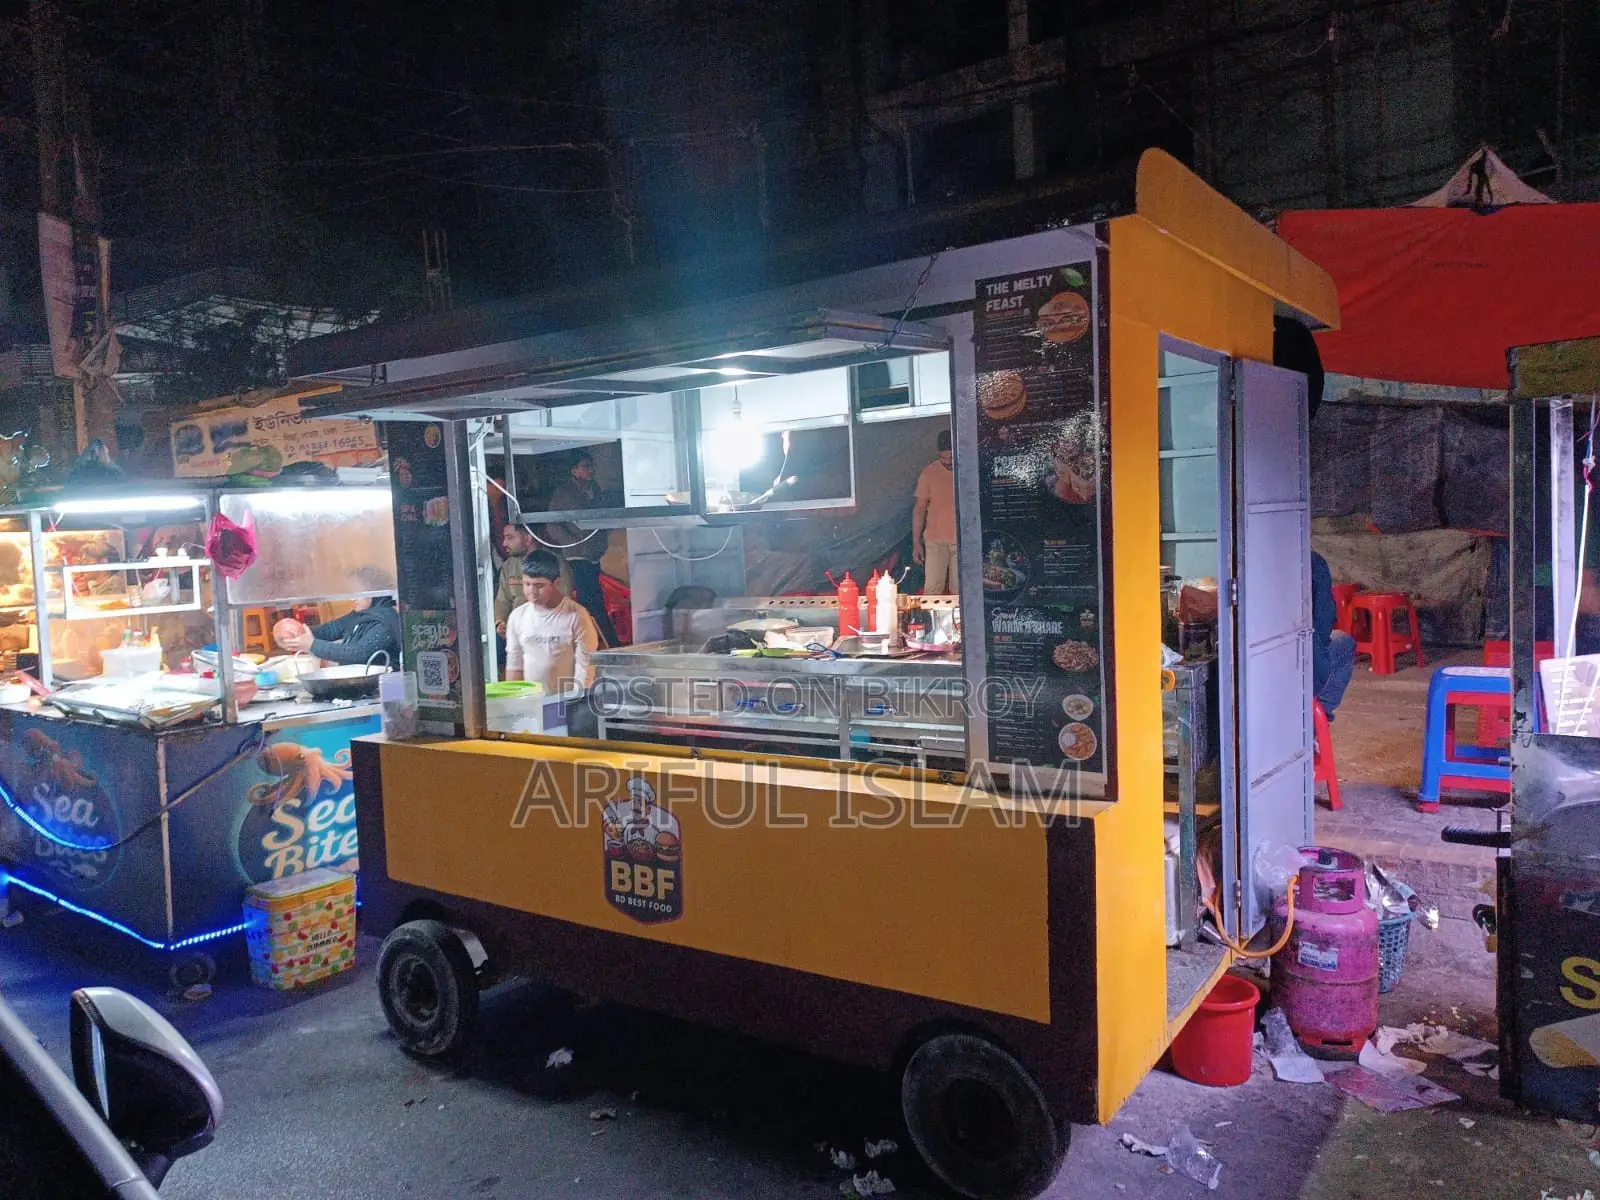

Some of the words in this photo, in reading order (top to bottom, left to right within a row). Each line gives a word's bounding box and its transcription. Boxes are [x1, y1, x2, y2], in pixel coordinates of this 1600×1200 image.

[986, 281, 1009, 296] THE
[1013, 274, 1053, 292] MELTY
[985, 295, 1025, 312] FEAST
[411, 624, 436, 636] scan
[33, 782, 99, 829] Sea
[610, 859, 675, 900] BBF
[615, 894, 626, 904] BD
[628, 896, 647, 908] BEST
[648, 901, 672, 913] FOOD
[311, 929, 333, 941] HELLO
